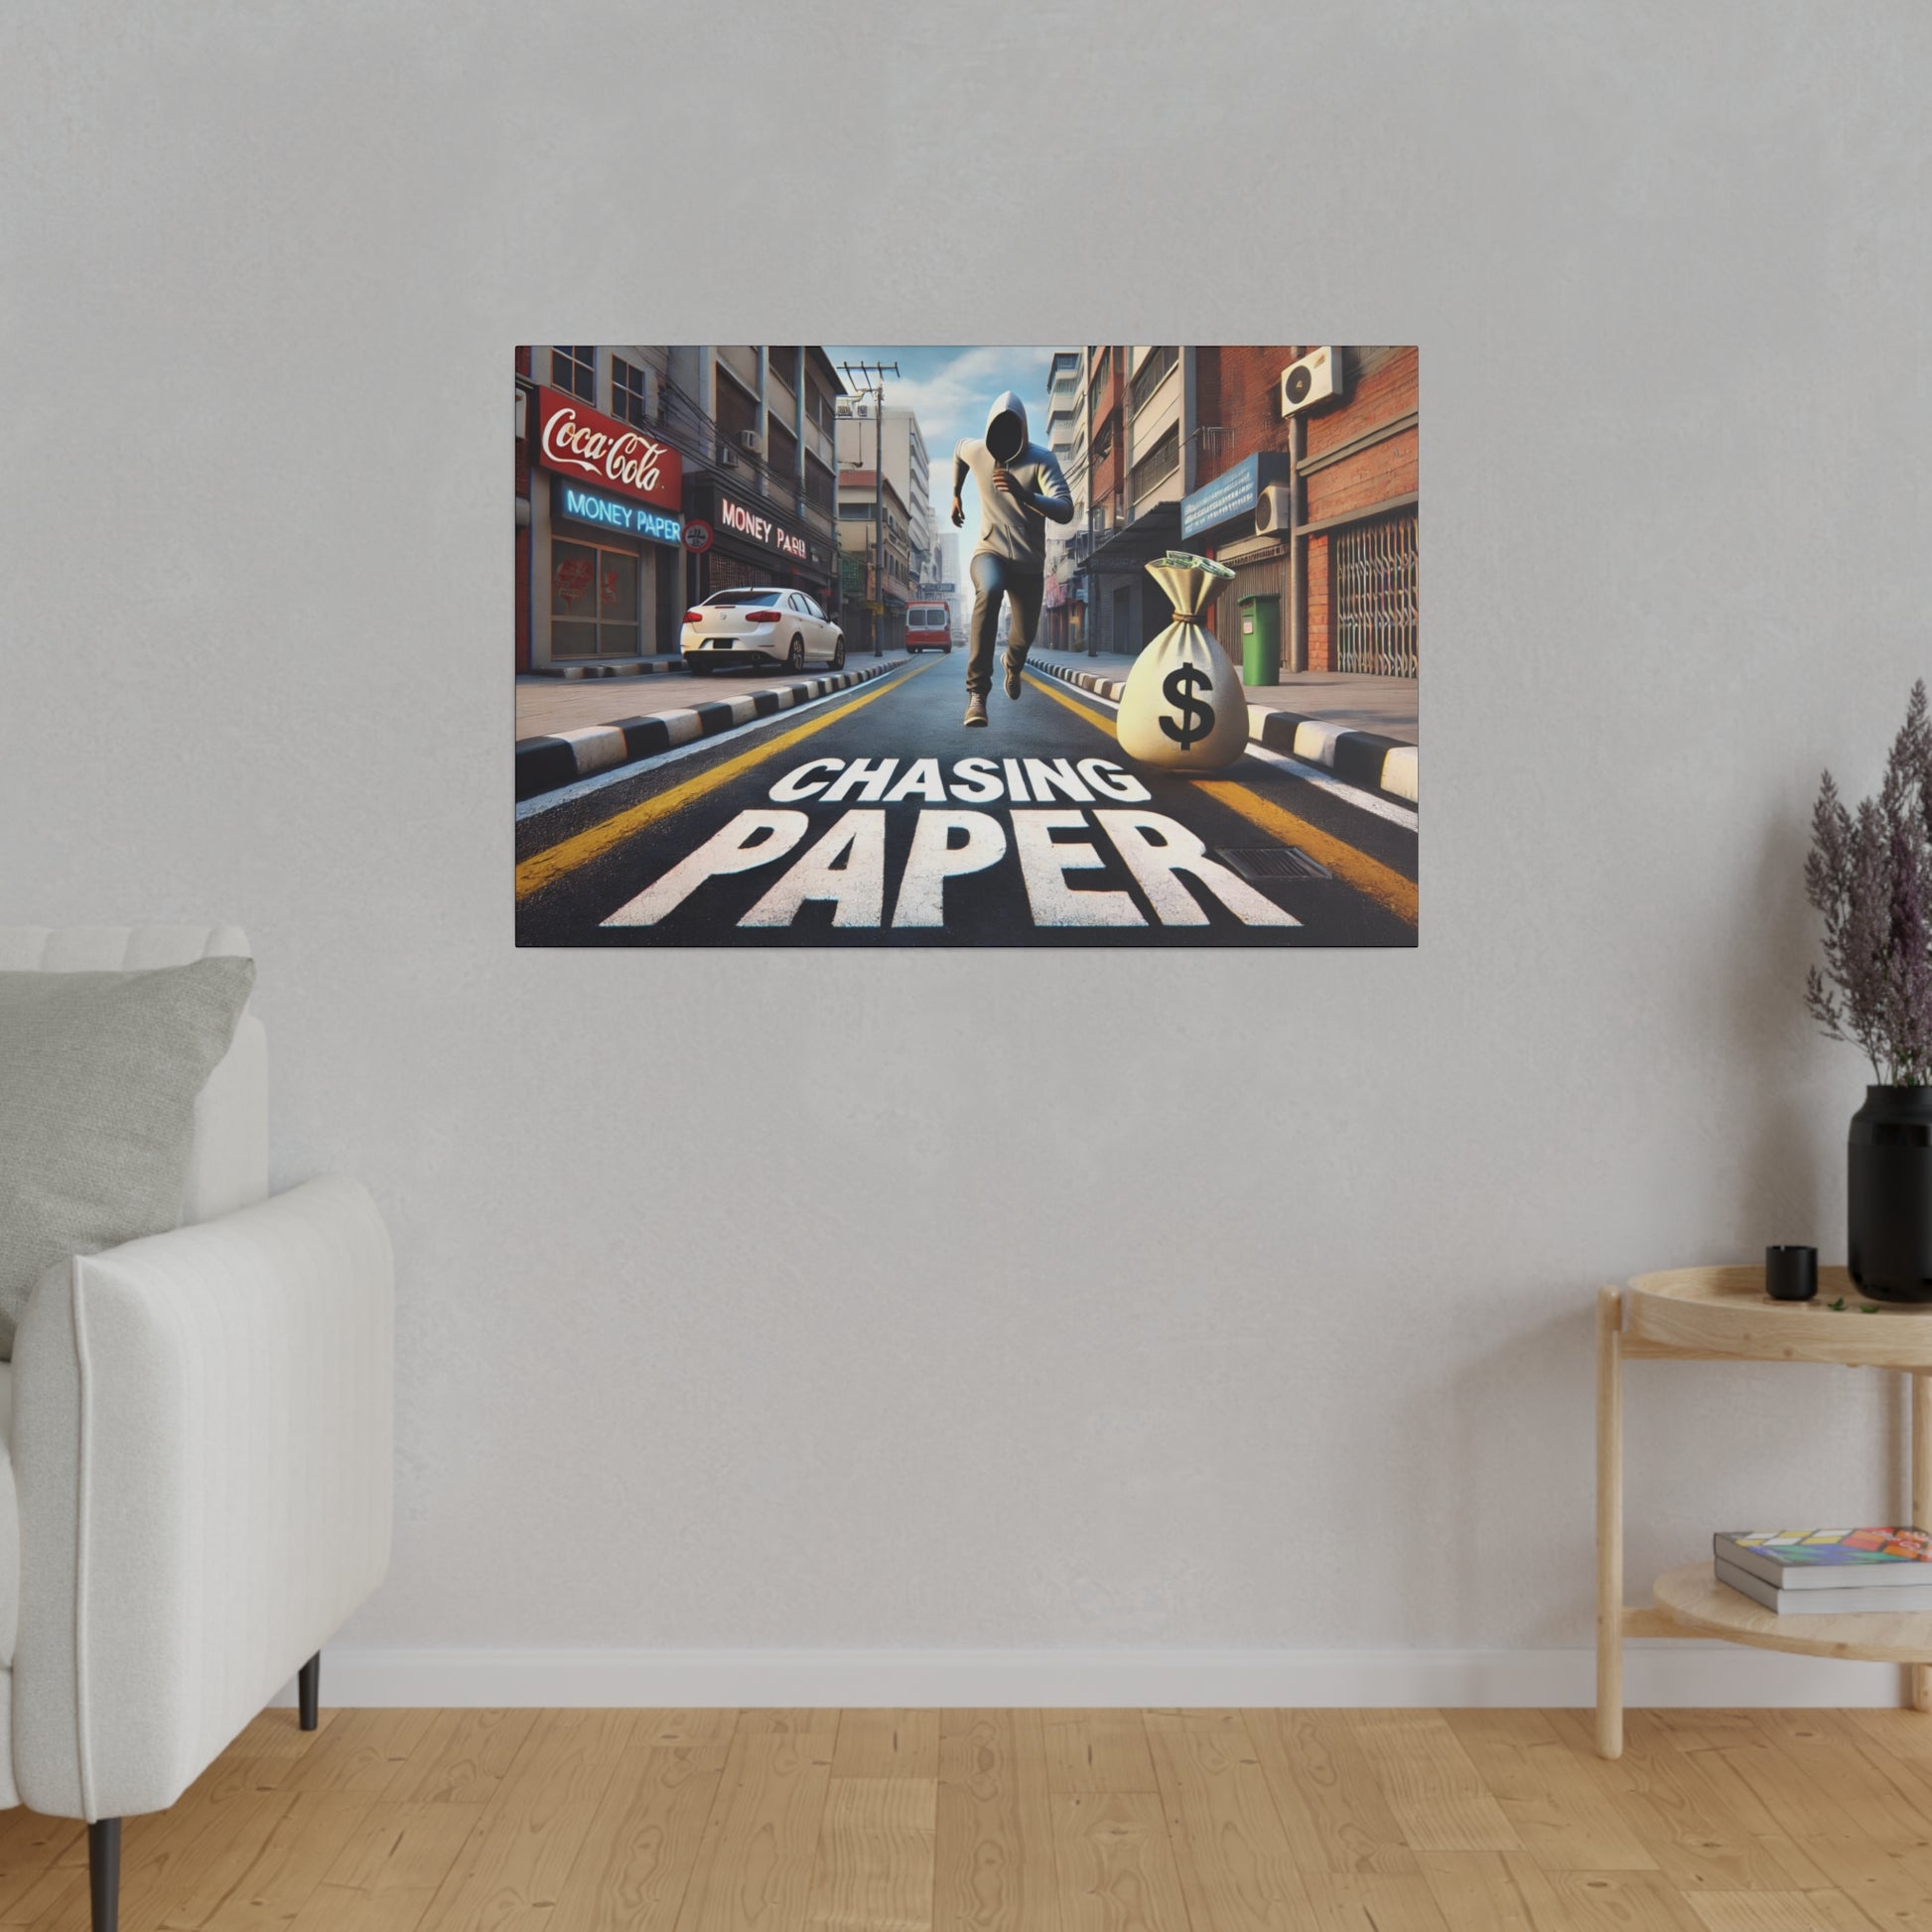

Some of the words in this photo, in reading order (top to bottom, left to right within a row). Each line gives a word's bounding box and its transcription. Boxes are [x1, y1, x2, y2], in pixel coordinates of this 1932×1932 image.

[567, 489, 632, 528] MONEY
[636, 510, 681, 542] PAPER
[722, 497, 772, 543] MONEY
[768, 758, 1152, 803] CHASING
[599, 808, 1303, 928] PAPER
